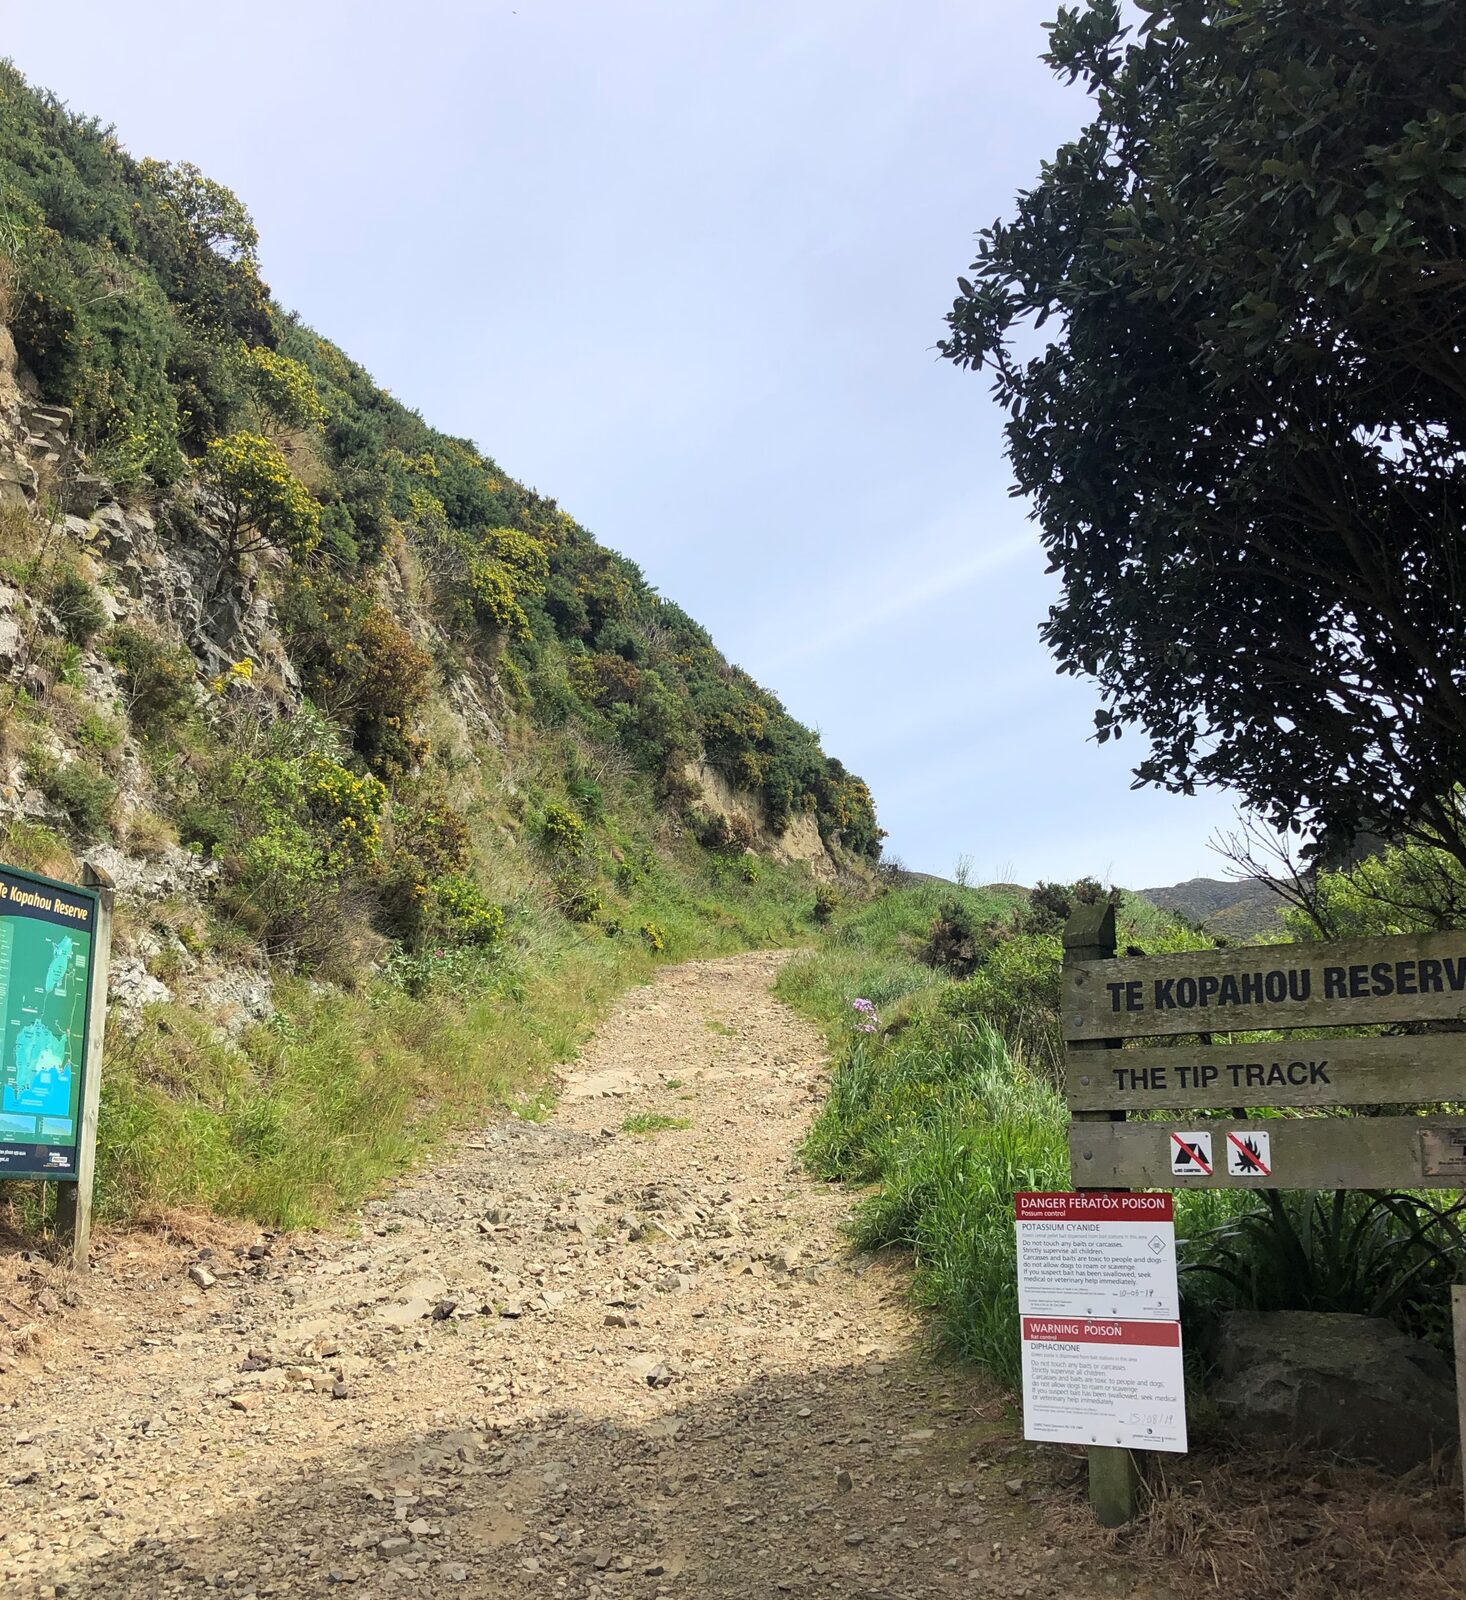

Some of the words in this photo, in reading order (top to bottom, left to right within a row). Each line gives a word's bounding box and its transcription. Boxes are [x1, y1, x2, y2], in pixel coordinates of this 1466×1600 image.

[0, 882, 8, 898] Te
[10, 886, 52, 911] Kopahou
[54, 898, 88, 920] Reserve
[1106, 980, 1144, 1012] TE
[1153, 969, 1311, 1010] KOPAHOU
[1323, 957, 1466, 999] RESERV
[1112, 1067, 1167, 1091] THE
[1174, 1065, 1218, 1089] TIP
[1226, 1061, 1331, 1087] TRACK
[1021, 1198, 1066, 1209] DANGER
[1069, 1198, 1119, 1209] FERATOX
[1122, 1198, 1165, 1209] POISON
[1022, 1223, 1064, 1231] POTASSIUM
[1066, 1224, 1100, 1232] CYANIDE
[1030, 1323, 1078, 1334] WARNING
[1084, 1326, 1122, 1336] POISON
[1031, 1342, 1080, 1352] DIPHACINONE
